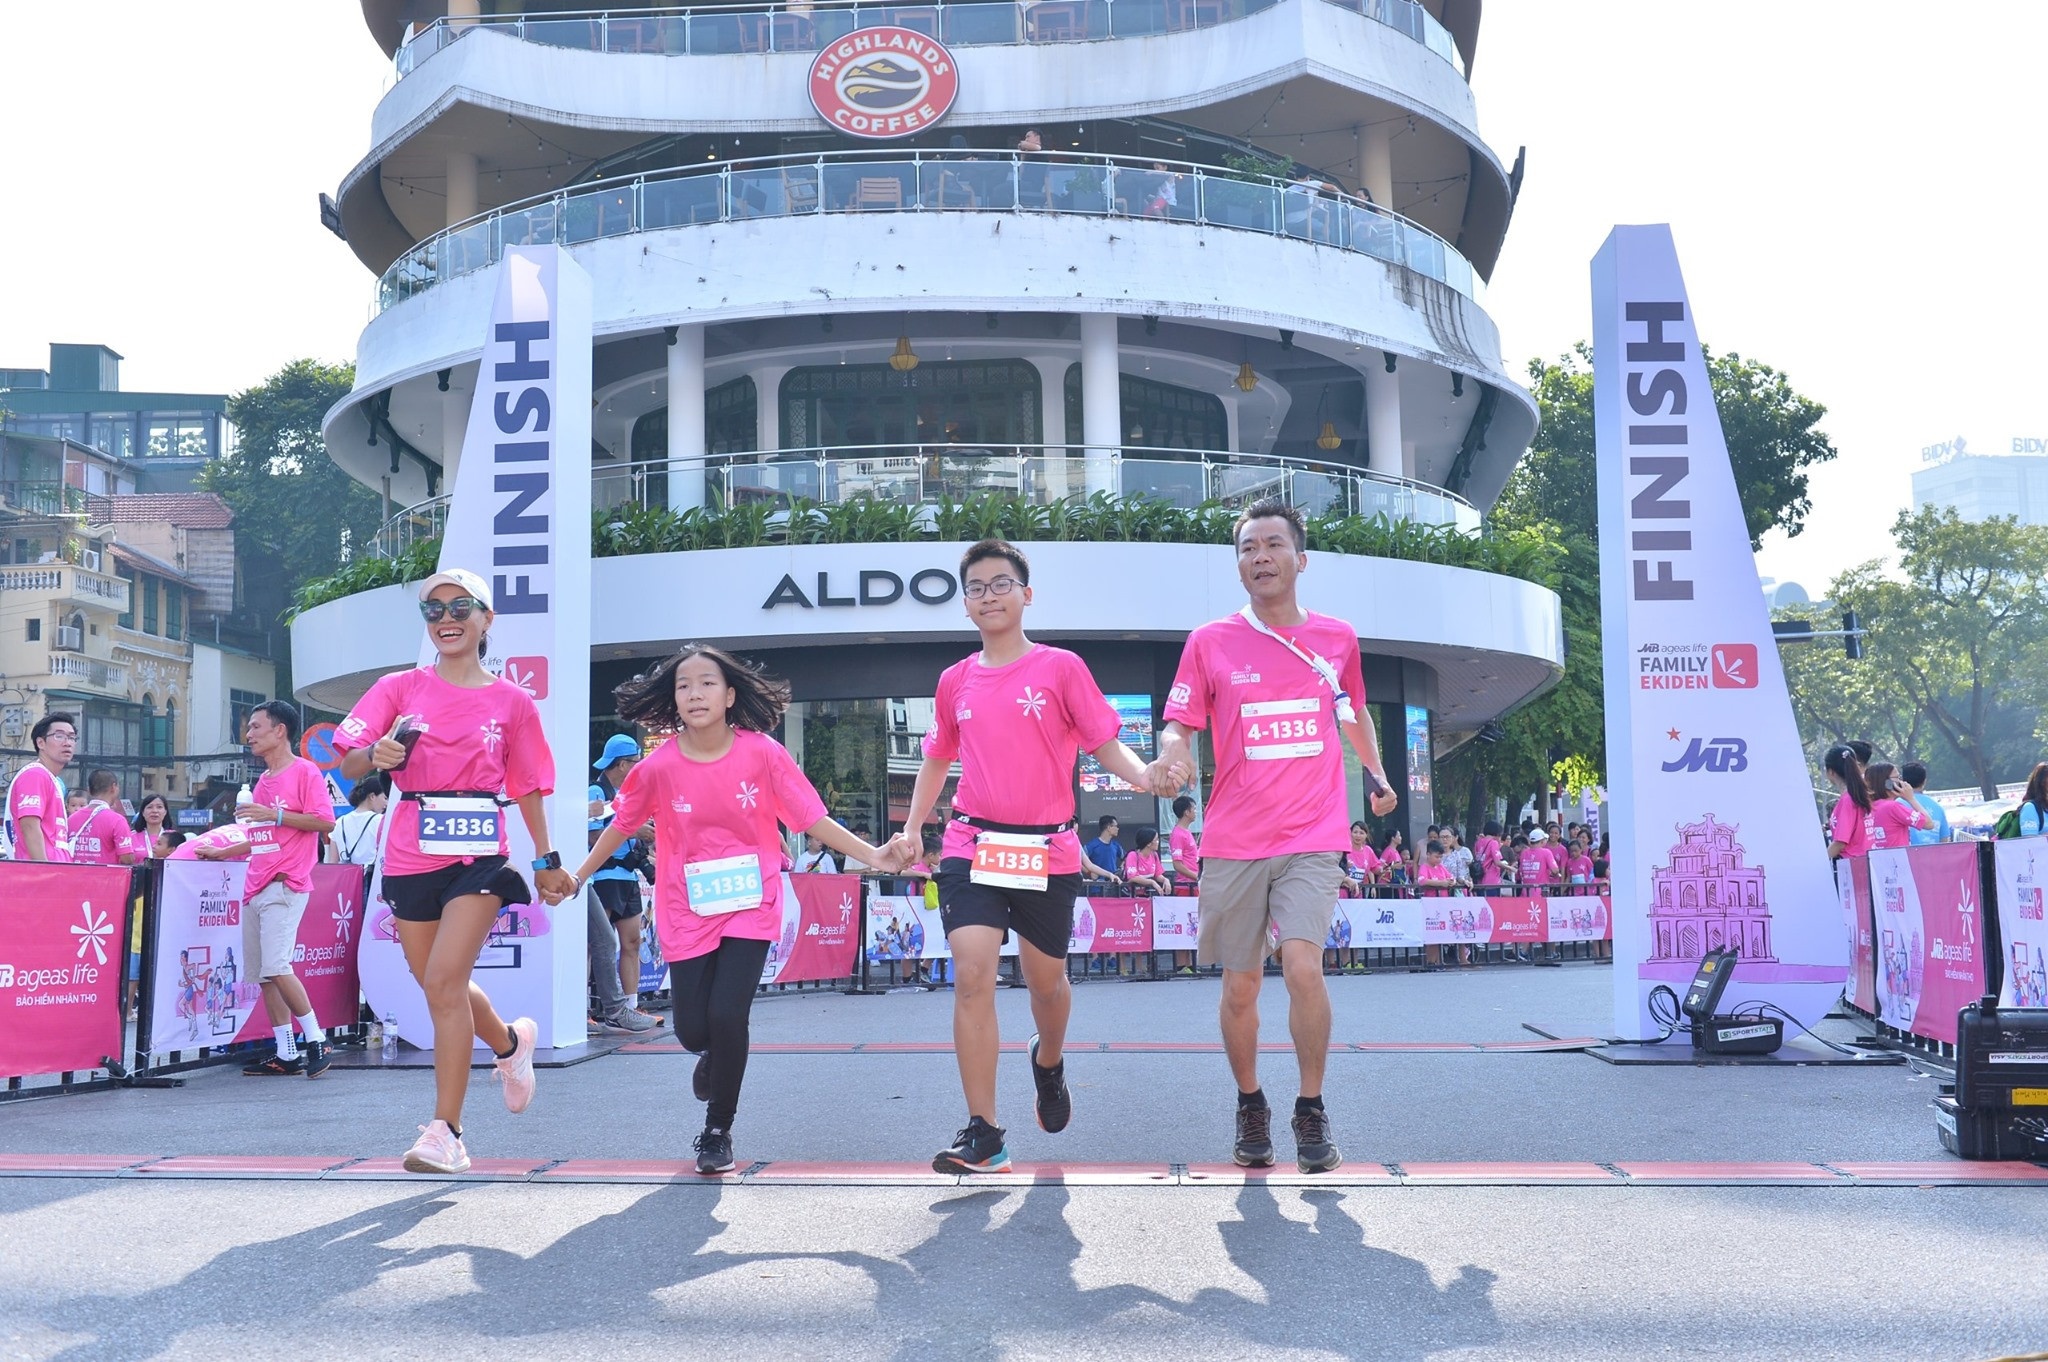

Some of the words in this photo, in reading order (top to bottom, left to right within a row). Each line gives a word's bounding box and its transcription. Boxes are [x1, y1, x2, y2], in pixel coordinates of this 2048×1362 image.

[817, 33, 949, 81] HIGHLANDS
[834, 103, 936, 132] COFFEE
[1626, 302, 1694, 600] FINISH
[1922, 440, 1952, 462] BIDV
[2012, 437, 2048, 453] BIDV
[493, 320, 551, 614] FINISH
[761, 568, 957, 610] ALDO
[1637, 643, 1660, 653] MB
[1661, 646, 1690, 655] ageas
[1692, 643, 1708, 653] life
[1640, 656, 1708, 672] FAMILY
[1640, 675, 1709, 690] EKIDEN
[1248, 718, 1318, 741] 4-1336
[1661, 738, 1748, 772] MB
[423, 817, 495, 837] 2-1336
[977, 850, 1043, 871] 1-1336
[691, 873, 758, 899] 3-1336
[200, 901, 228, 913] FAMILY
[199, 915, 226, 927] EKIDEN
[820, 926, 838, 938] ageas
[1115, 930, 1132, 939] ageas
[1133, 928, 1142, 937] life
[306, 946, 333, 965] ageas
[333, 942, 346, 958] life
[1944, 944, 1962, 966] ageas
[17, 968, 69, 992] ageas
[72, 963, 98, 984] life
[15, 993, 33, 1006] BẢO
[34, 991, 54, 1005] HIỂM
[55, 992, 79, 1004] NHÂN
[80, 993, 97, 1004] THỌ
[1731, 1025, 1774, 1037] SPORTSTATS
